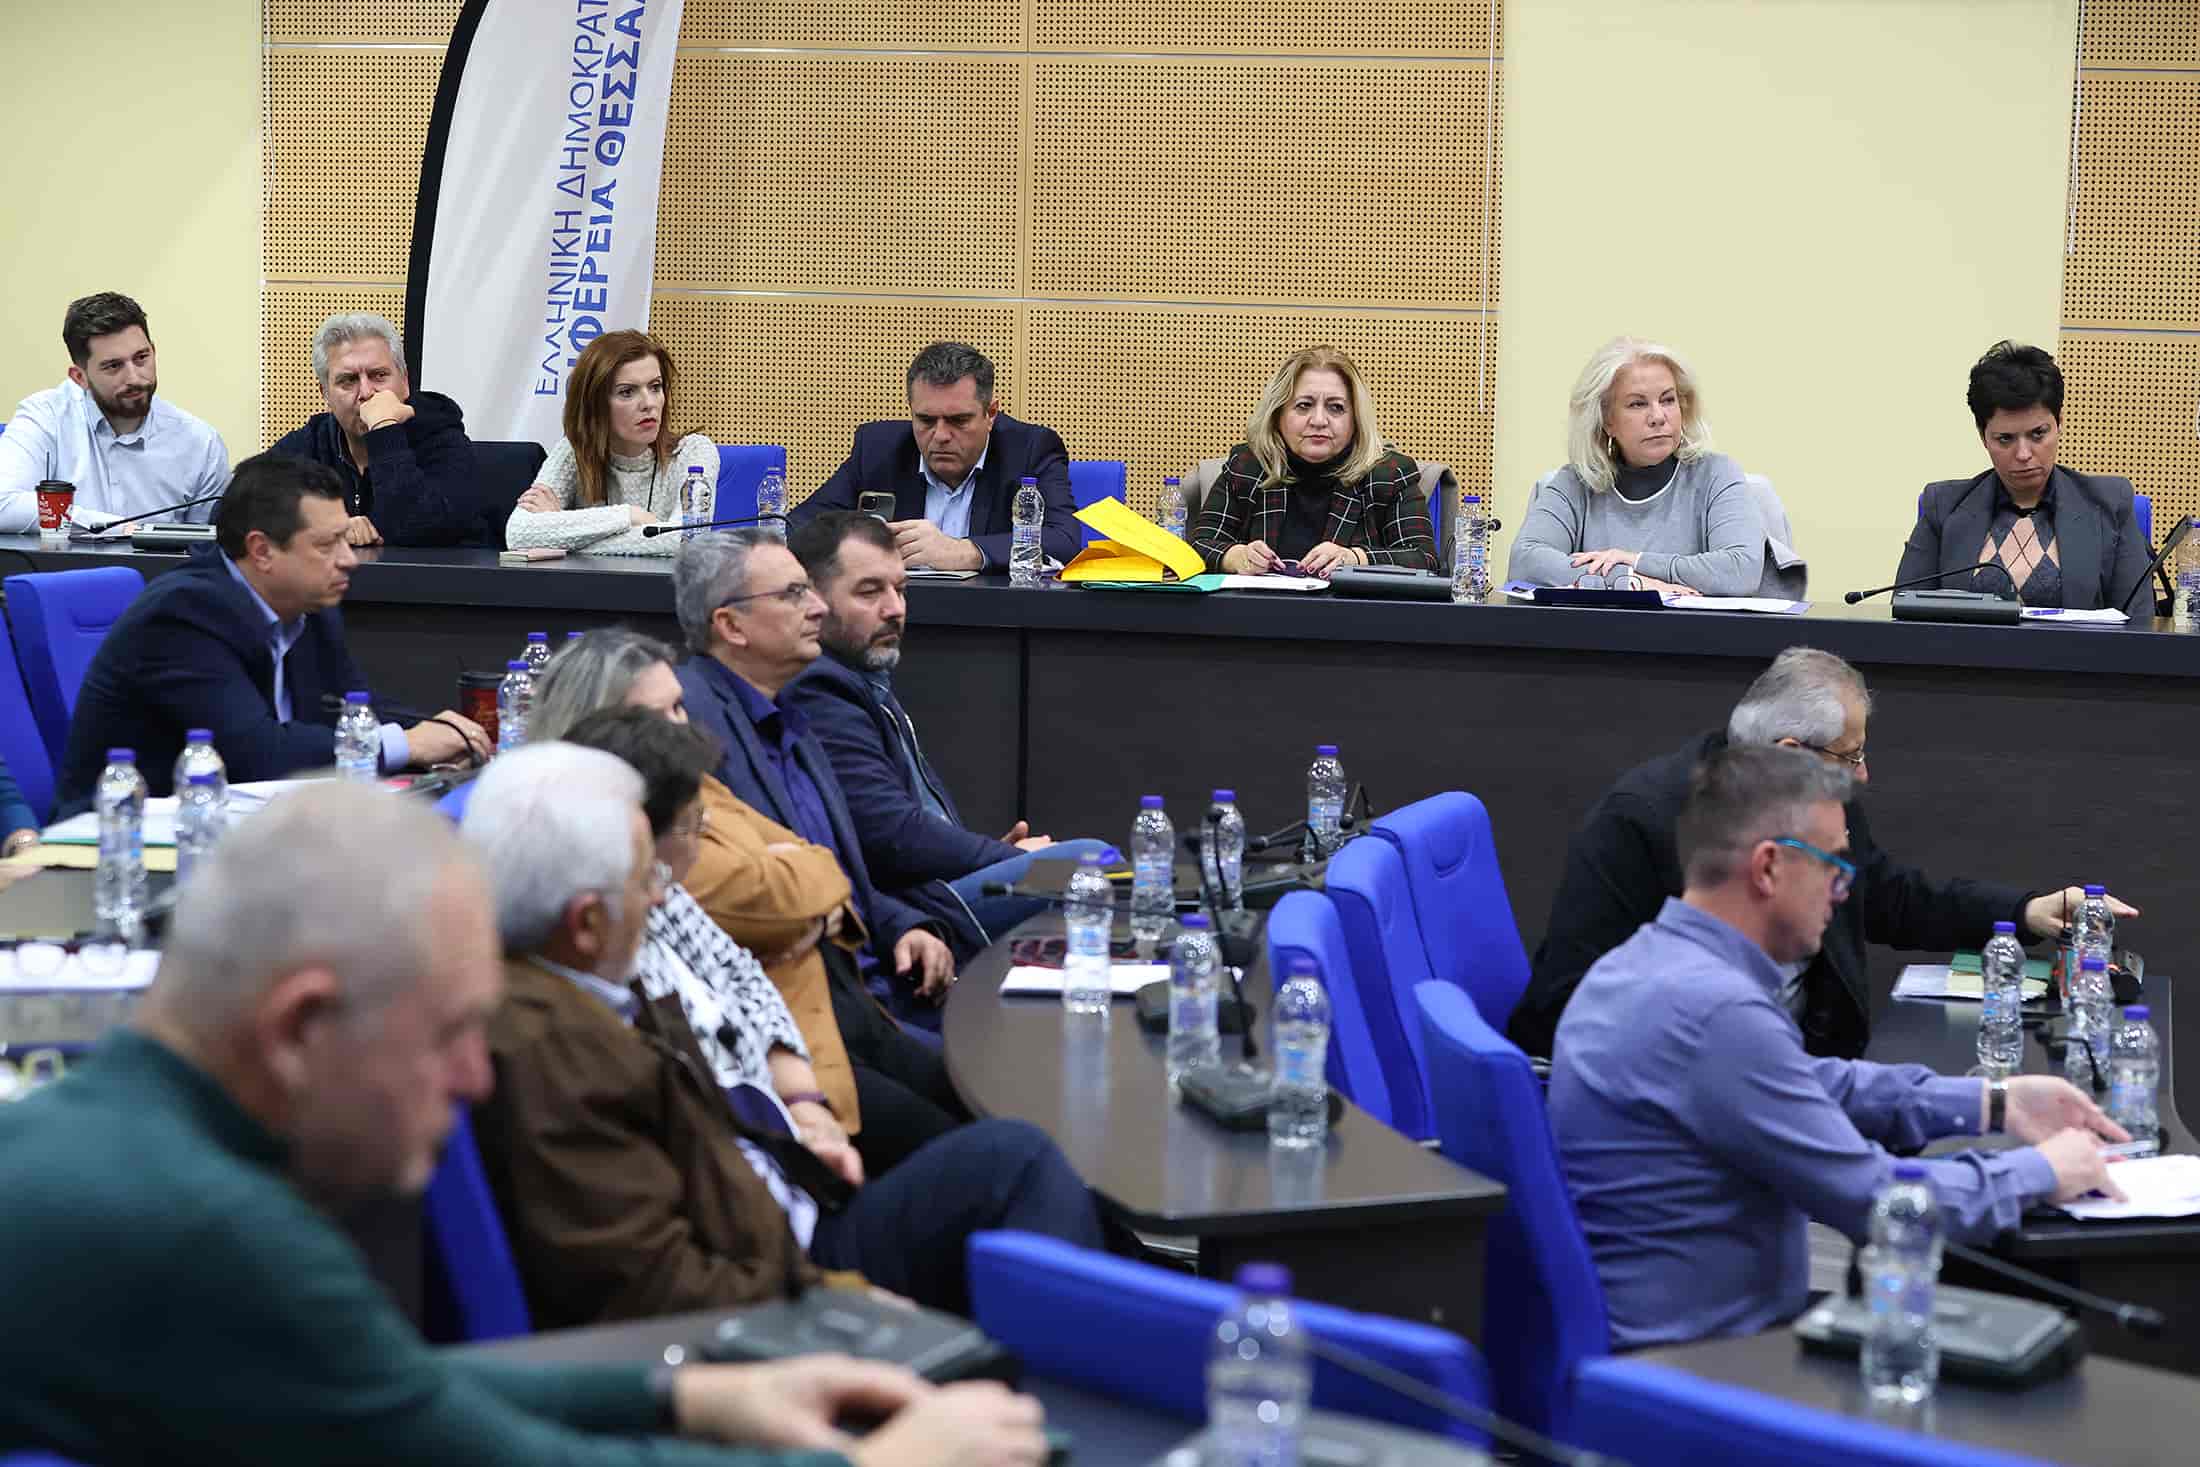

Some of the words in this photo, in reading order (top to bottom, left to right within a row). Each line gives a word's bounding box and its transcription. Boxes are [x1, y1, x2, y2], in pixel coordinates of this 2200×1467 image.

[535, 211, 582, 395] ΕΛΛΗΝΙΚΗ
[566, 178, 616, 396] ΦΕΡΕΙΑ
[595, 0, 646, 167] ΘΕΣΣΑ
